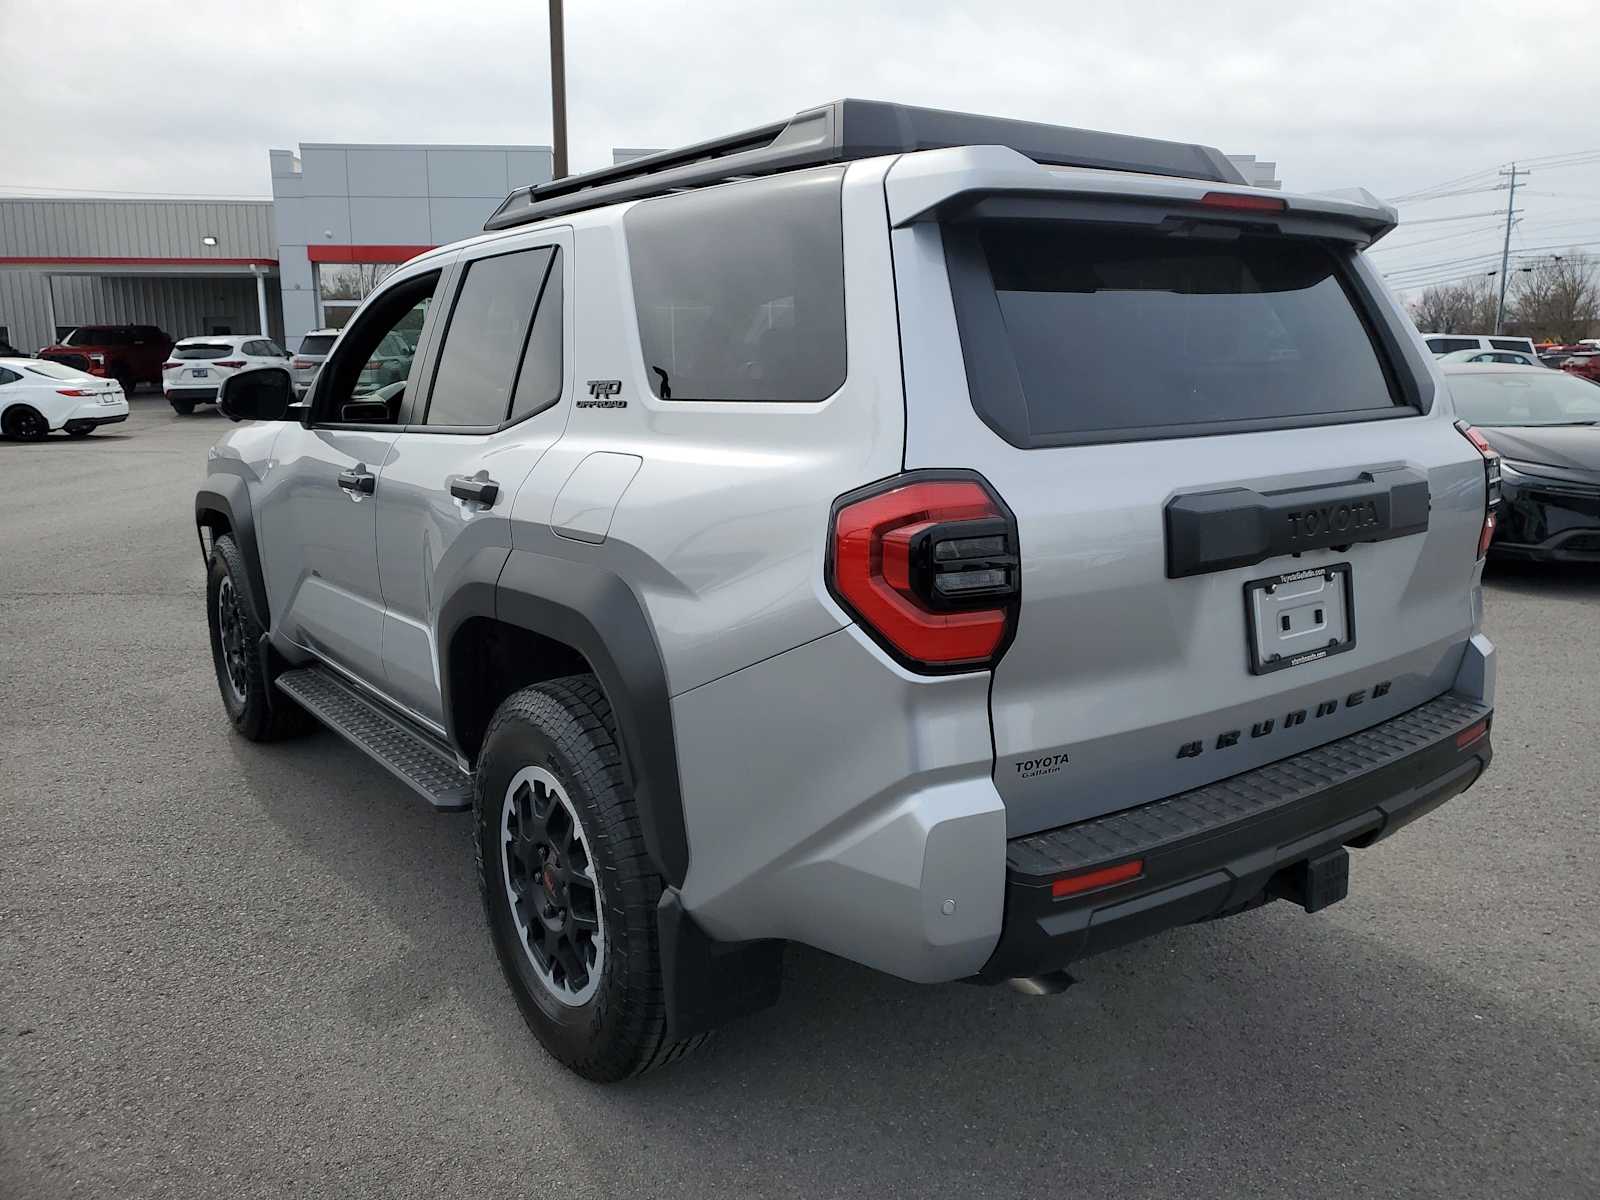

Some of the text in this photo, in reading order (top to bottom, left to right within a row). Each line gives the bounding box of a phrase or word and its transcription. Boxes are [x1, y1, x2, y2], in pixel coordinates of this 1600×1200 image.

[586, 380, 622, 400] TRD
[1287, 502, 1378, 540] TOYOTA
[1176, 681, 1393, 759] 4RUNNER
[1015, 754, 1069, 773] TOYOTA
[1021, 767, 1061, 779] Gallatin
